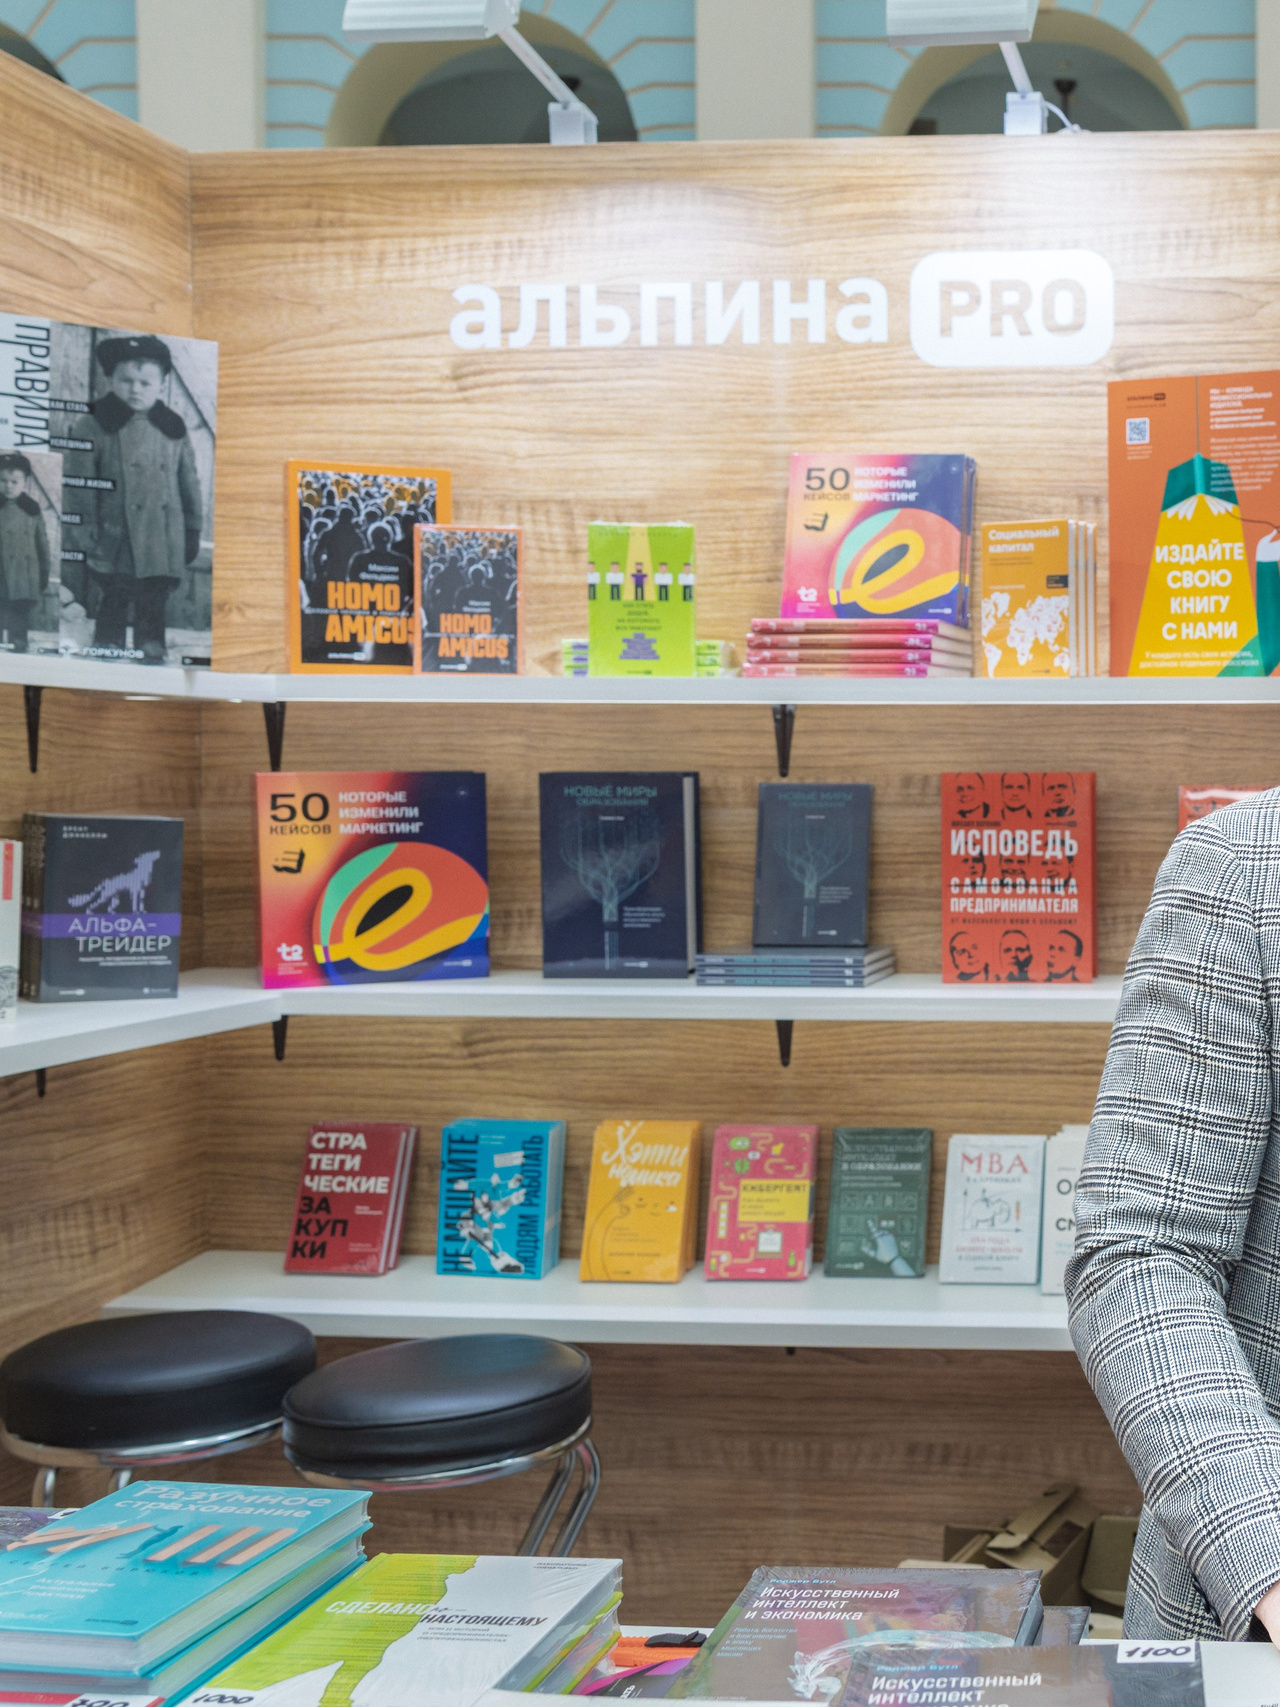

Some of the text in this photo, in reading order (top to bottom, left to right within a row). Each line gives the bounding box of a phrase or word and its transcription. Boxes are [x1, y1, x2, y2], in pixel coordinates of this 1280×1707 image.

[448, 277, 889, 350] альпина
[938, 278, 1088, 339] PRO
[14, 322, 51, 447] ПРАВИЛА
[804, 467, 851, 491] 50
[854, 466, 908, 478] КОТОРЫЕ
[803, 491, 851, 501] КЕЙСОВ
[852, 491, 920, 503] МАРКЕТИНГ
[988, 526, 1060, 542] Социальный
[988, 542, 1035, 554] капитал
[1154, 538, 1245, 565] ИЗДАЙТЕ
[1165, 568, 1233, 590] СВОЮ
[326, 580, 401, 612] HOMO
[1169, 594, 1231, 616] КНИГУ
[439, 612, 493, 635] HOMO
[1161, 620, 1239, 641] С НАМИ
[82, 646, 145, 660] ГОРКУНОВ
[437, 637, 510, 659] AMICUS
[338, 790, 408, 804] КОТОРЫЕ
[269, 792, 330, 823] 50
[338, 805, 420, 819] ИЗМЕНИЛИ
[269, 824, 332, 836] КЕЙСОВ
[338, 821, 424, 835] МАРКЕТИНГ
[950, 828, 1079, 859] ИСПОВЕДЬ
[950, 877, 1079, 896] САМОЗВАНЦА
[950, 897, 1079, 914] ПРЕДПРИНИМАТЕЛЯ
[68, 917, 157, 934] АЛЬФА-
[75, 932, 172, 954] ТРЕЙДЕР
[277, 943, 304, 961] t2
[310, 1131, 367, 1150] СТРА
[308, 1153, 362, 1172] ТЕГИ
[959, 1151, 1030, 1175] MBA
[304, 1174, 390, 1194] ЧЕСКИЕ
[298, 1196, 332, 1215] ЗА
[515, 1134, 545, 1275] ЛЮДЯМ РАБОТАТЬ
[295, 1218, 348, 1237] КУП
[291, 1240, 327, 1259] КИ
[442, 1247, 474, 1273] НЕ
[133, 1485, 332, 1510] Разумное
[114, 1500, 312, 1518] страхование
[759, 1586, 900, 1600] Искусственный
[325, 1600, 431, 1617] СДЕЛАНО
[752, 1599, 850, 1610] интеллект
[419, 1613, 549, 1627] НАСТОЯЩЕМУ
[744, 1611, 863, 1621] и экономика
[1124, 1646, 1192, 1660] 1100
[871, 1672, 1042, 1692] Искусственный
[867, 1689, 985, 1706] интеллект
